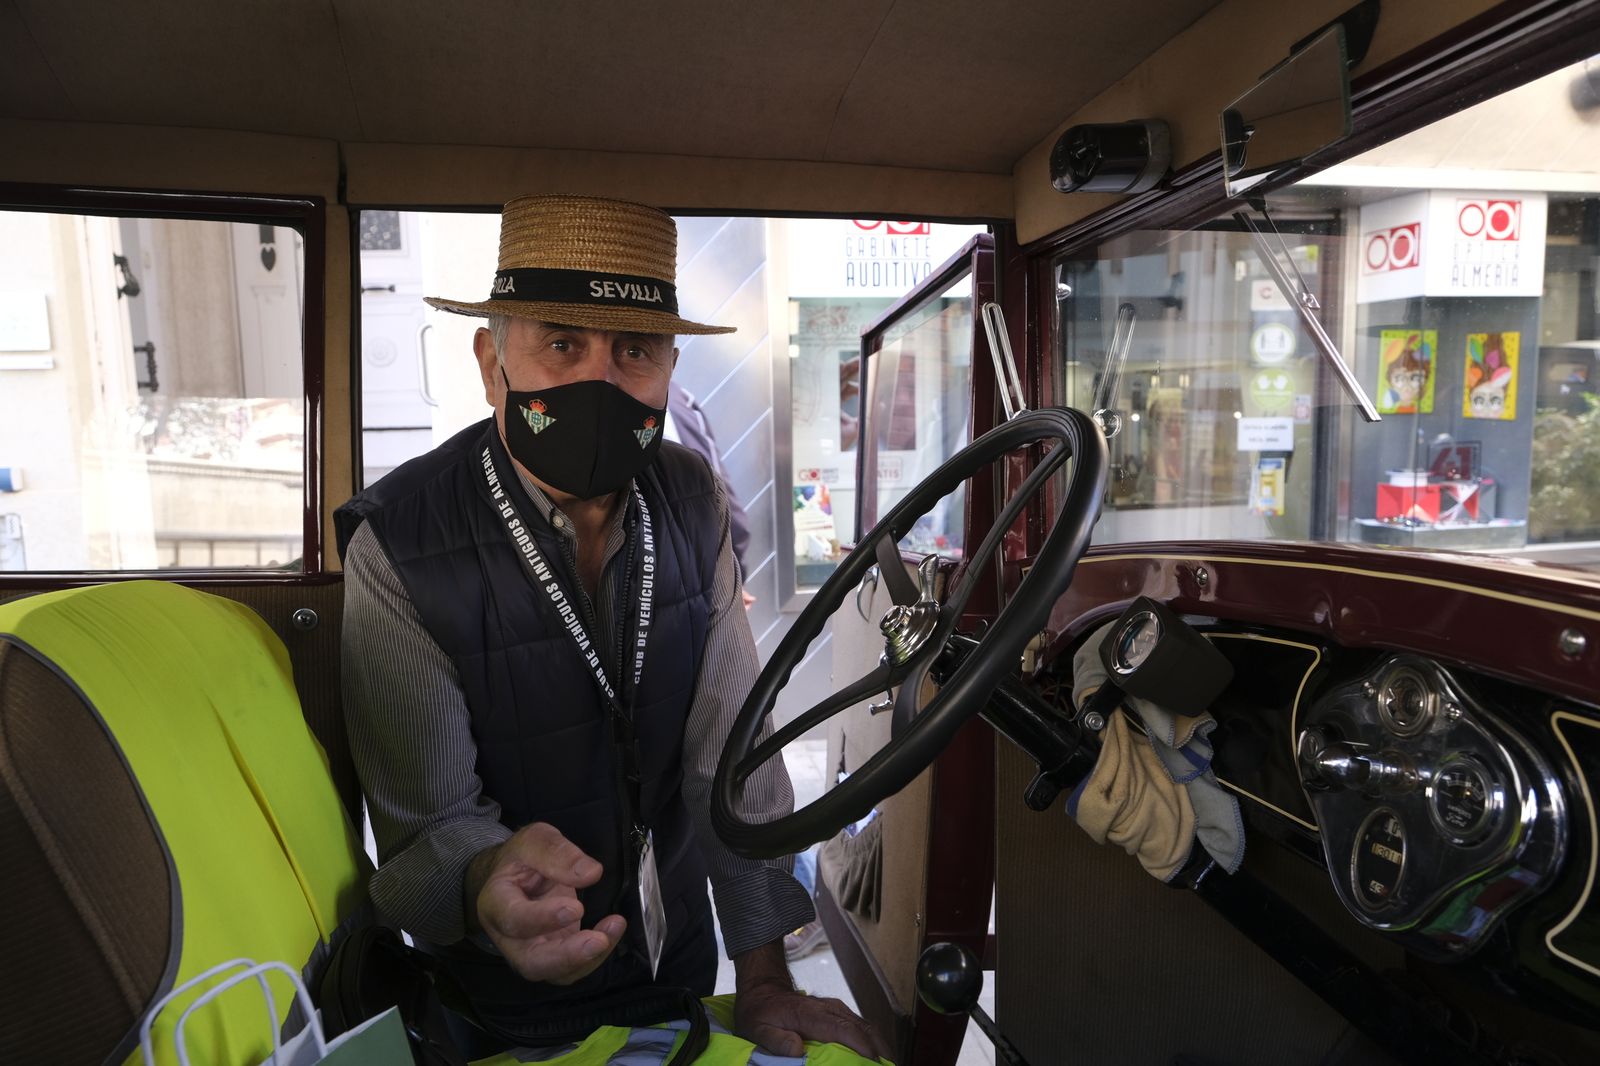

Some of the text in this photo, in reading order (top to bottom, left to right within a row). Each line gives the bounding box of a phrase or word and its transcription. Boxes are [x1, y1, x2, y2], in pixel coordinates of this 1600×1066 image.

[846, 237, 931, 258] GABINETE
[1451, 264, 1519, 287] ALMERIA
[589, 280, 663, 303] SEVILLA
[635, 492, 654, 552] ANTIGUOS
[481, 447, 616, 699] CLUB DE VEHÍCULOS ANTIGUOS DE ALMERÍA
[639, 554, 656, 627] VEHÍCULOS
[636, 630, 648, 647] DE
[633, 651, 647, 685] CLUB
